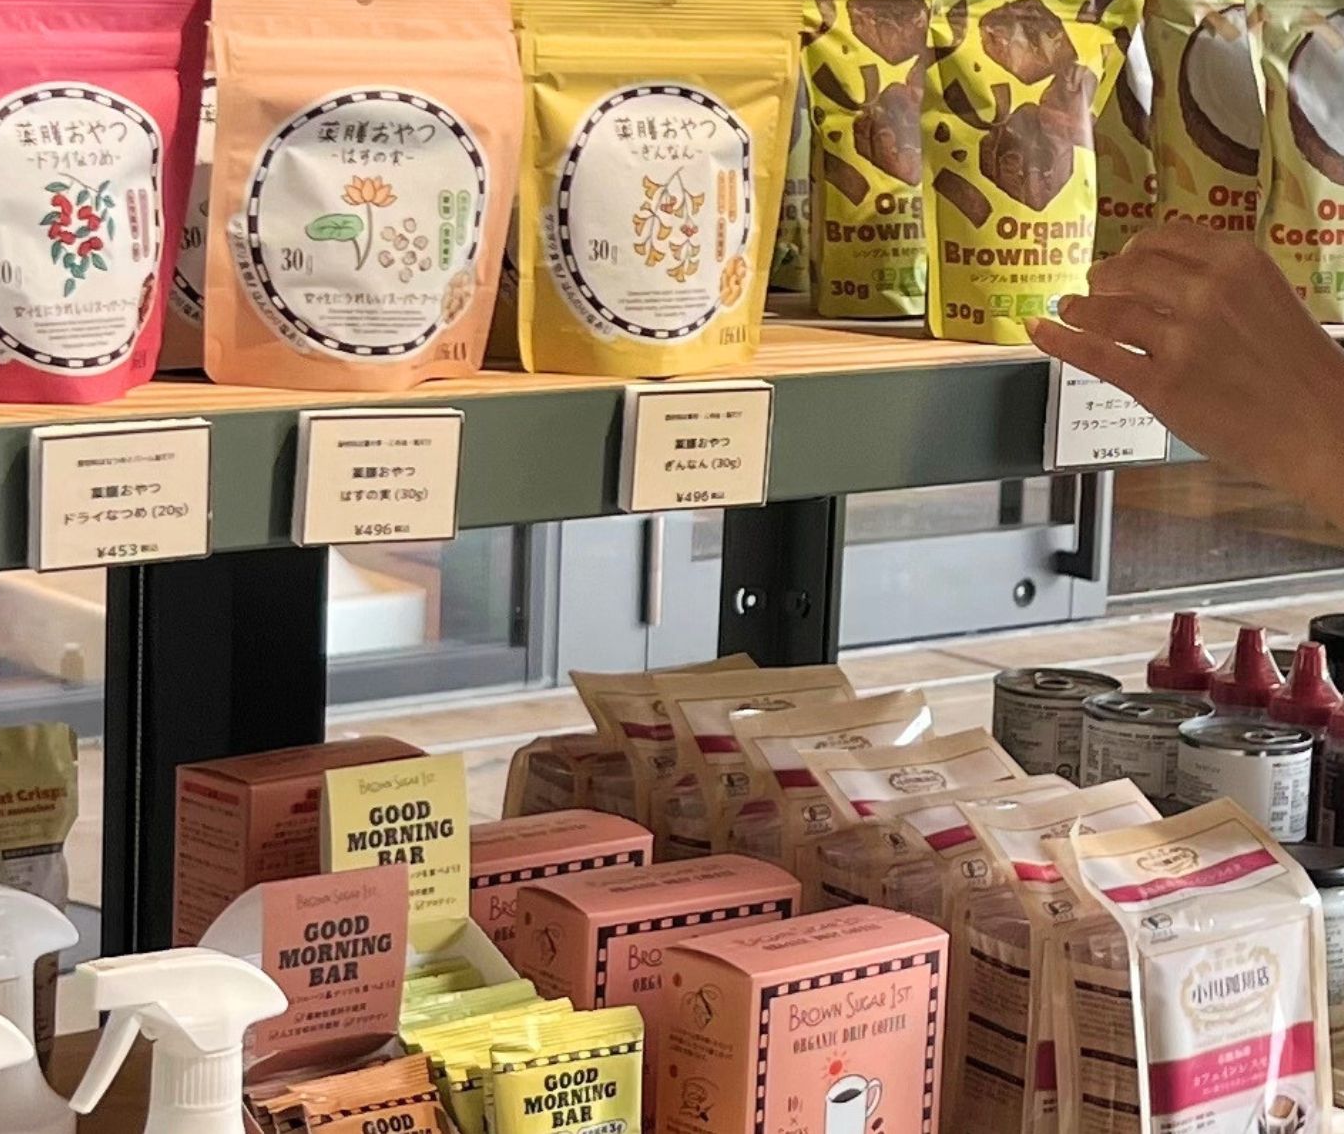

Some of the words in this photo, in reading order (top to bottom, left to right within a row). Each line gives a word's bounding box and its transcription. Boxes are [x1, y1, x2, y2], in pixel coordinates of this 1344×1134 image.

[15, 120, 129, 147] 薬膳おやつ
[318, 121, 436, 144] 薬膳おやつ
[613, 118, 717, 141] 薬膳おやつ
[281, 248, 313, 275] 30g
[588, 240, 618, 264] 30g
[944, 240, 1063, 266] Brownie
[831, 280, 870, 300] 30g
[946, 302, 984, 325] 30g
[395, 487, 428, 502] (30g)
[152, 503, 189, 519] (20g)
[355, 524, 392, 536] ¥496
[97, 544, 138, 558] ¥453
[369, 801, 431, 827] GOOD
[347, 818, 454, 852] MORNING
[378, 845, 425, 866] BAR
[304, 914, 370, 943] GOOD
[278, 933, 392, 970] MORNING
[308, 961, 359, 987] BAR
[789, 1000, 842, 1032] BROWN
[846, 991, 887, 1018] SUGAR
[793, 1029, 837, 1055] ORGANIC
[842, 1023, 868, 1043] DRIP
[872, 1015, 906, 1037] COFFEE
[544, 1067, 599, 1092] GOOD
[524, 1081, 617, 1115] MORNING
[362, 1113, 415, 1134] GOOD
[552, 1105, 593, 1129] BAR
